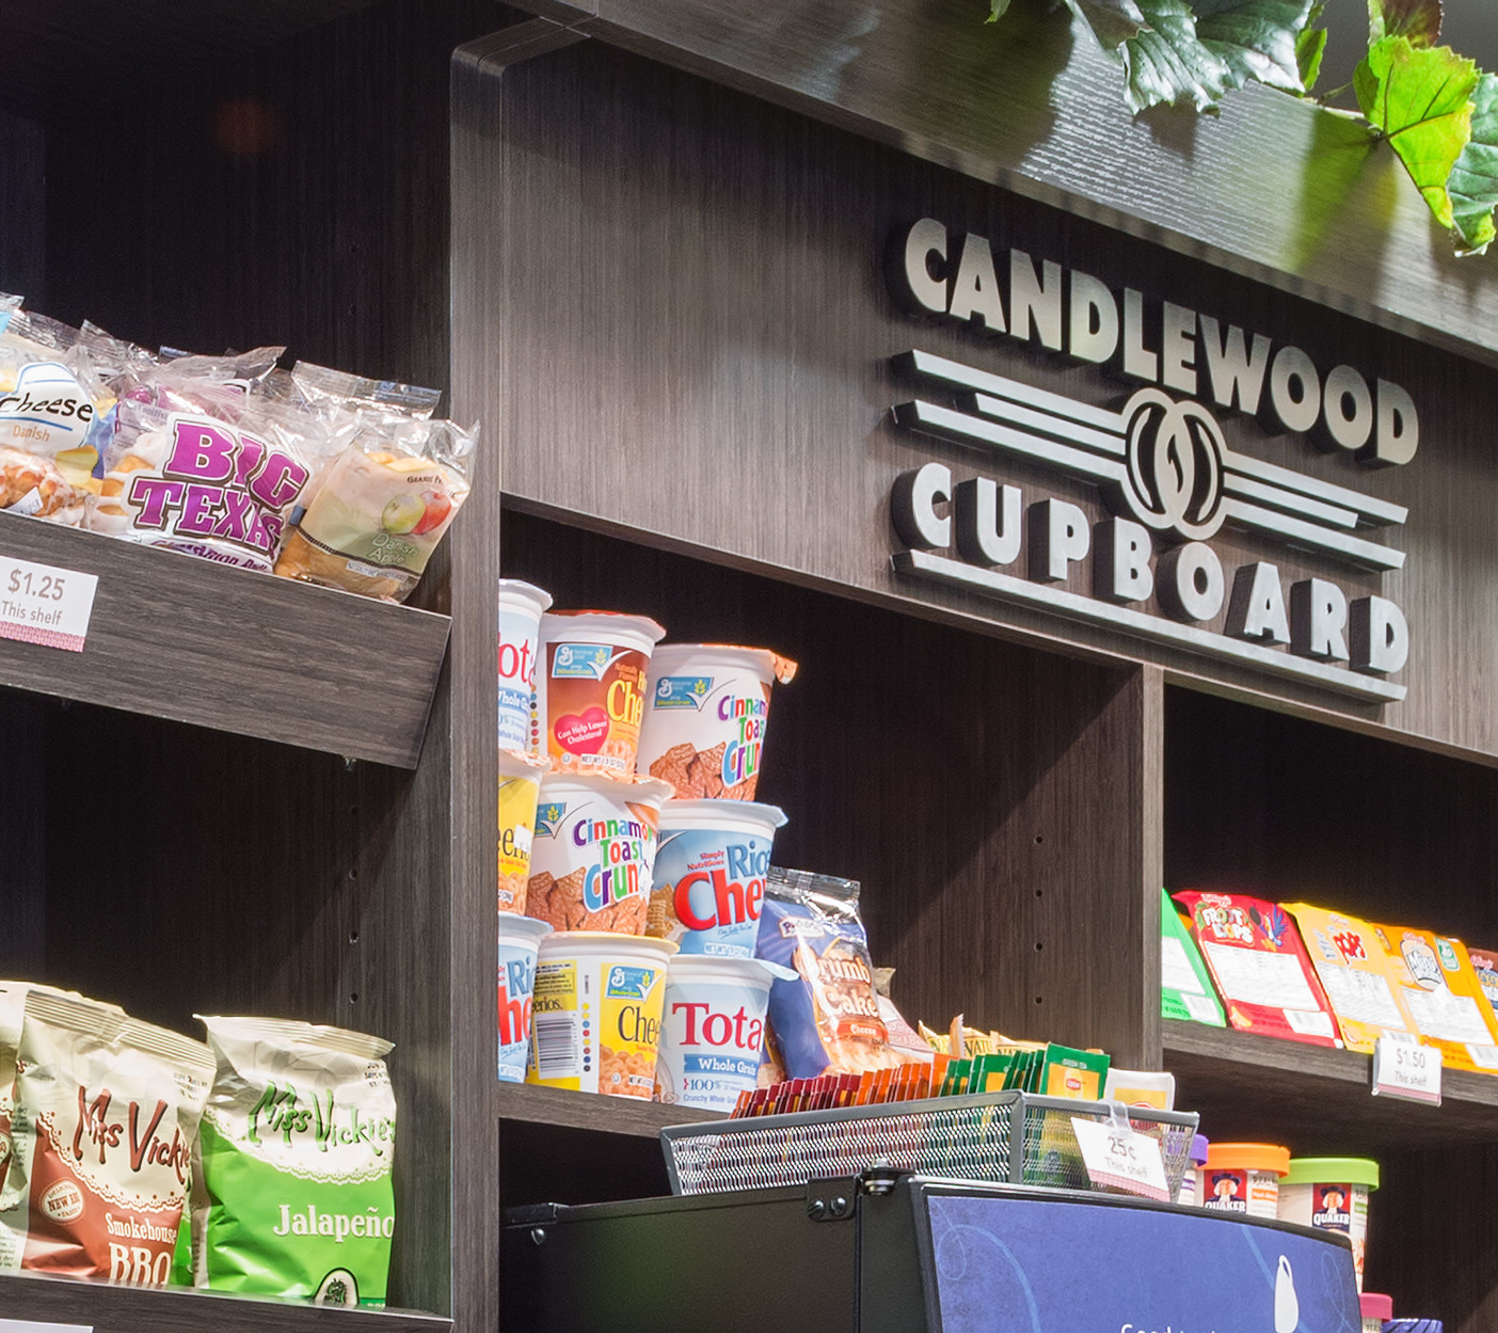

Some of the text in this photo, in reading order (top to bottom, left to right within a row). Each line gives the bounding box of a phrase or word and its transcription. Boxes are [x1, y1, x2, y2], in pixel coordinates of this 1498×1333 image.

[905, 217, 1419, 465] CANDLEWOOD
[13, 424, 51, 442] Danish
[164, 418, 308, 508] BIG
[7, 567, 66, 601] $1.25
[904, 462, 1409, 673] CUPBOARD
[600, 838, 644, 868] Toast
[850, 1025, 876, 1036] Cheese
[698, 1056, 734, 1073] Whole
[105, 1212, 177, 1245] Smokehouse
[273, 1204, 395, 1243] Jalapeño
[1313, 1212, 1350, 1226] QUAKER
